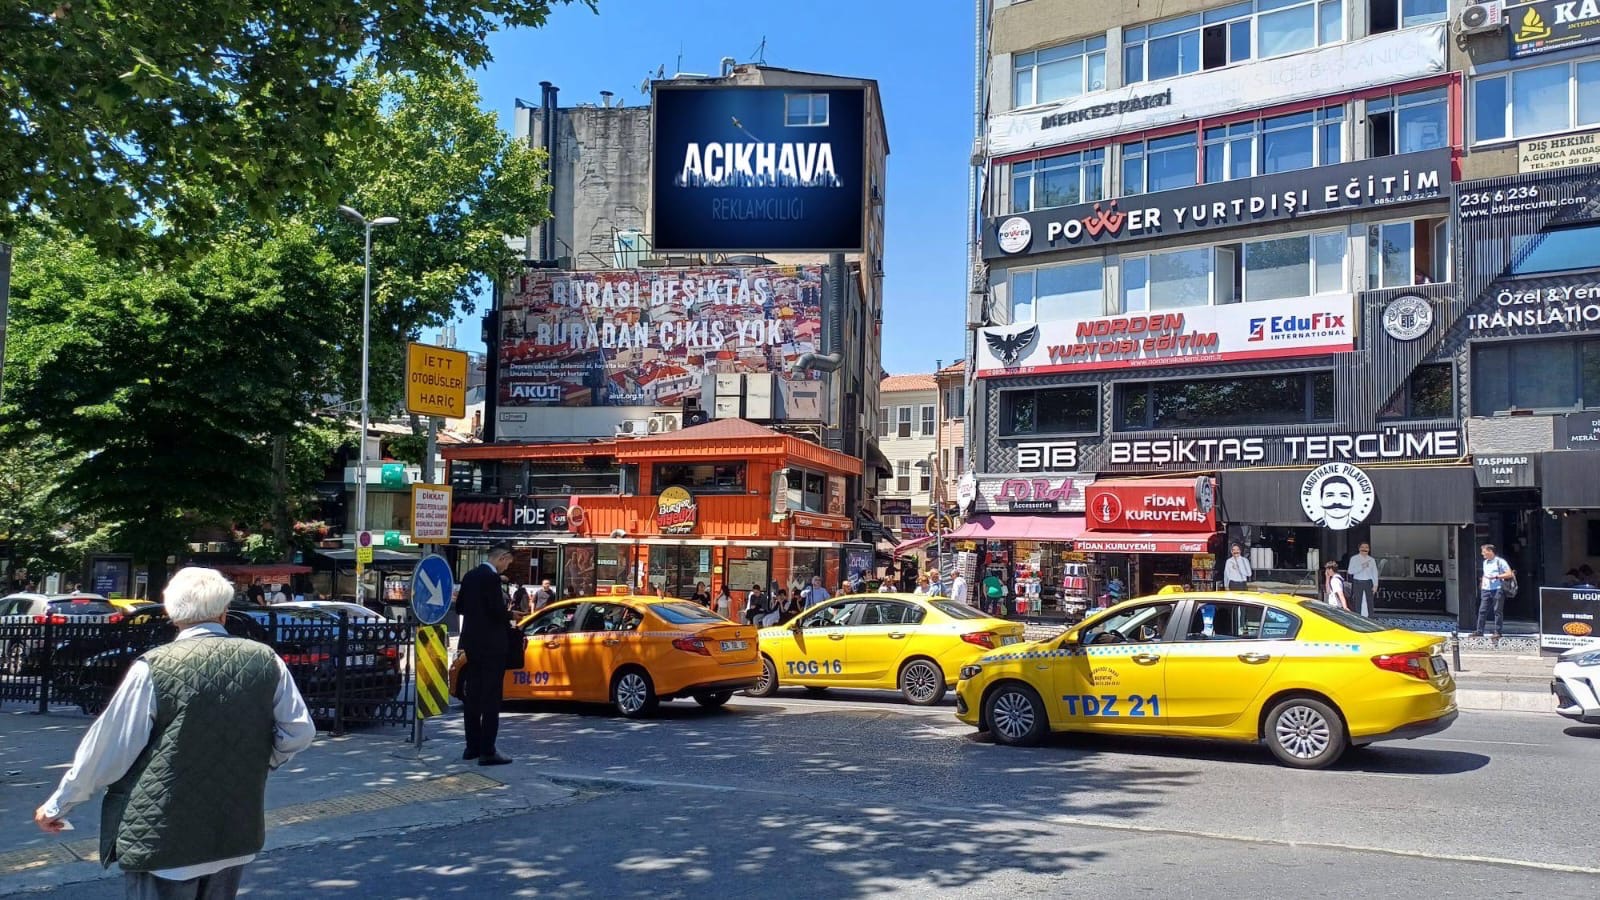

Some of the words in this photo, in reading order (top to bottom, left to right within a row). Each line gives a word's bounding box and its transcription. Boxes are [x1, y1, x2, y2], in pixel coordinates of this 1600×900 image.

[1528, 140, 1548, 152] DİŞ
[1551, 134, 1595, 148] HEKİMİ
[1522, 150, 1566, 163] A.GONCA
[1460, 192, 1490, 207] 236
[1494, 190, 1504, 202] 6
[1508, 185, 1538, 200] 236
[1048, 200, 1161, 242] POWER
[1173, 188, 1309, 224] YURTDIŞI
[1324, 169, 1440, 203] EĞİTİM
[553, 279, 640, 309] BURASI
[1497, 288, 1541, 306] Özel
[1075, 312, 1184, 338] NORDEN
[1270, 312, 1345, 333] EduFix
[537, 321, 649, 349] BURADAN
[659, 319, 726, 351] ÇIKIŞ
[735, 318, 784, 347] YOK
[1270, 331, 1346, 341] INTERNATIONAL
[1047, 339, 1139, 359] YURTDIŞI
[1143, 330, 1218, 352] EĞİTİM
[424, 352, 453, 370] İETT
[411, 371, 463, 390] OTOBÜSLERİ
[420, 392, 455, 408] HARİÇ
[512, 385, 559, 398] AKUT
[1017, 441, 1077, 468] BTB
[1111, 434, 1264, 467] BEŞİKTAŞ
[1283, 427, 1459, 460] TERCÜME
[1476, 456, 1529, 467] TAŞPINAR
[1302, 464, 1339, 496] BARUTHANE
[1491, 467, 1514, 475] HAN
[422, 491, 445, 501] DİKKAT
[1013, 501, 1053, 509] Accessories
[1143, 494, 1186, 507] FİDAN
[514, 505, 546, 525] PİDE
[1125, 508, 1207, 524] KURUYEMİŞ
[1077, 542, 1104, 551] FİDAN
[1105, 542, 1157, 552] KURUYEMİŞ
[1415, 563, 1441, 574] KASA
[786, 660, 819, 675] TOG
[822, 659, 842, 674] 16
[512, 671, 533, 685] TBL
[534, 671, 550, 684] 09
[1063, 694, 1120, 717] TDZ
[1128, 694, 1160, 717] 21
